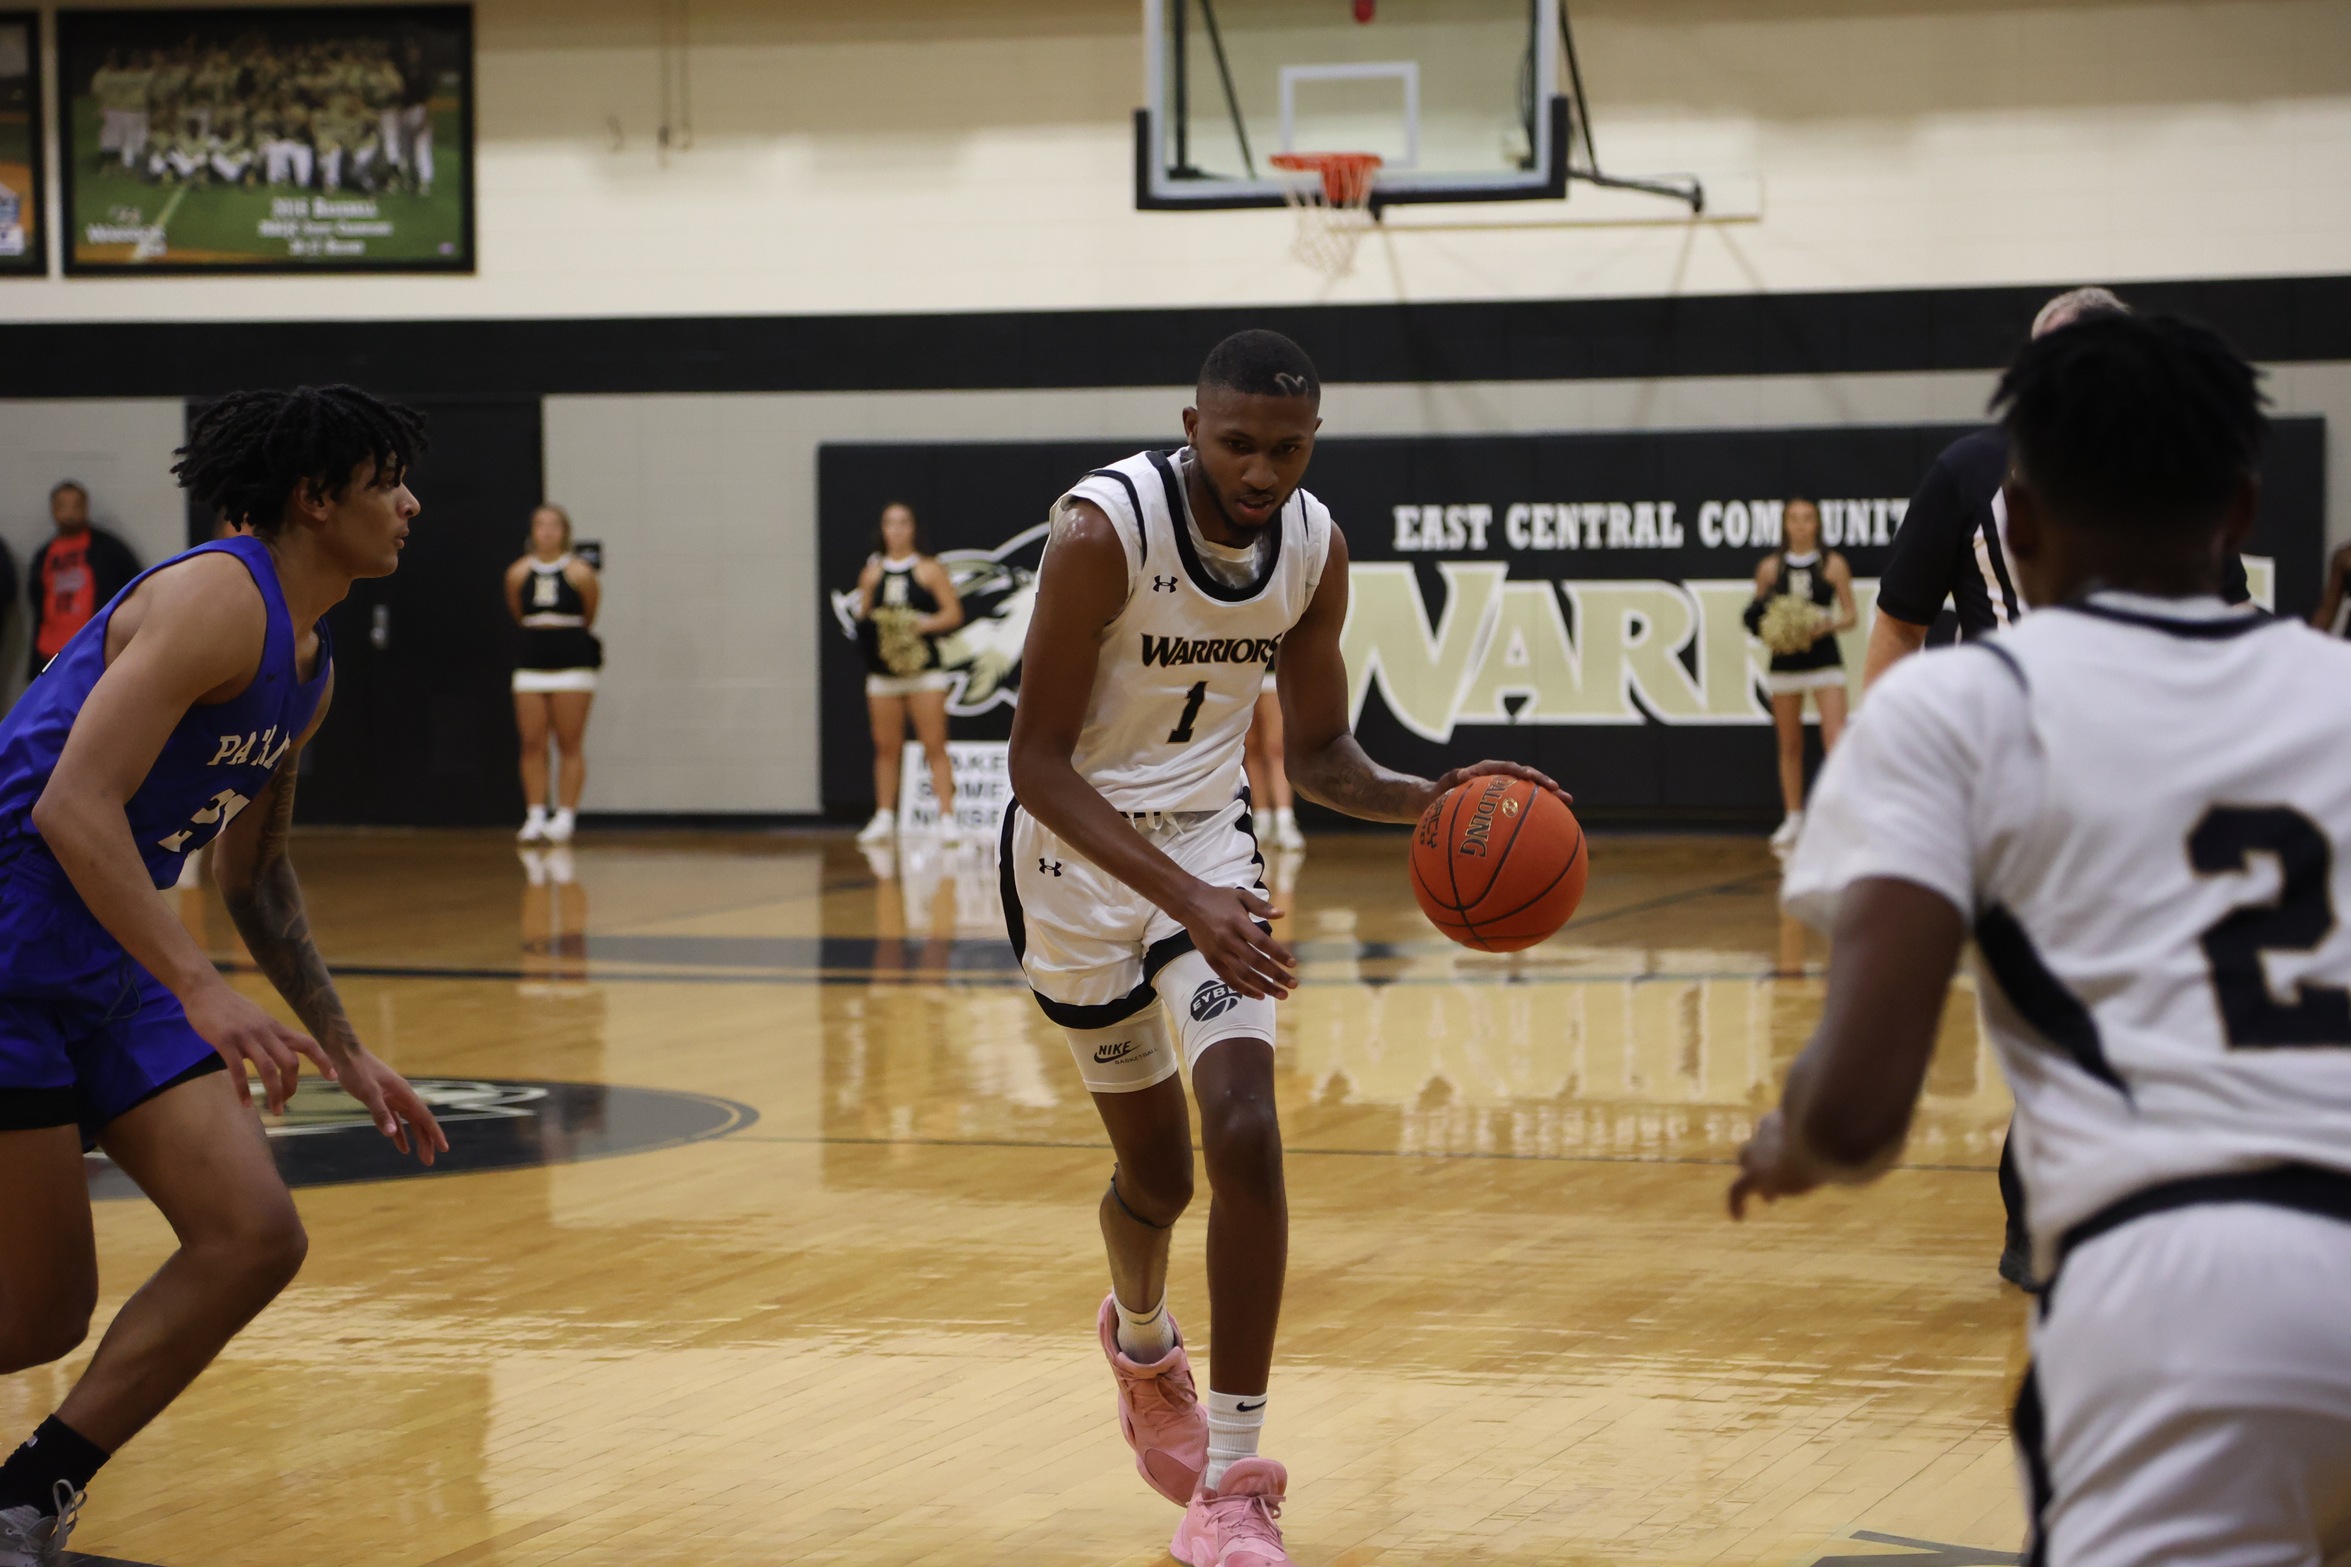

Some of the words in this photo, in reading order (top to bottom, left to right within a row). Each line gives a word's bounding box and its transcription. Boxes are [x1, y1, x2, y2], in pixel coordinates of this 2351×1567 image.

[1393, 505, 1493, 551] EAST
[1505, 502, 1684, 550] CENTRAL
[1165, 680, 1208, 744] 1
[2185, 804, 2351, 1050] 2
[1099, 1041, 1131, 1056] NIKE
